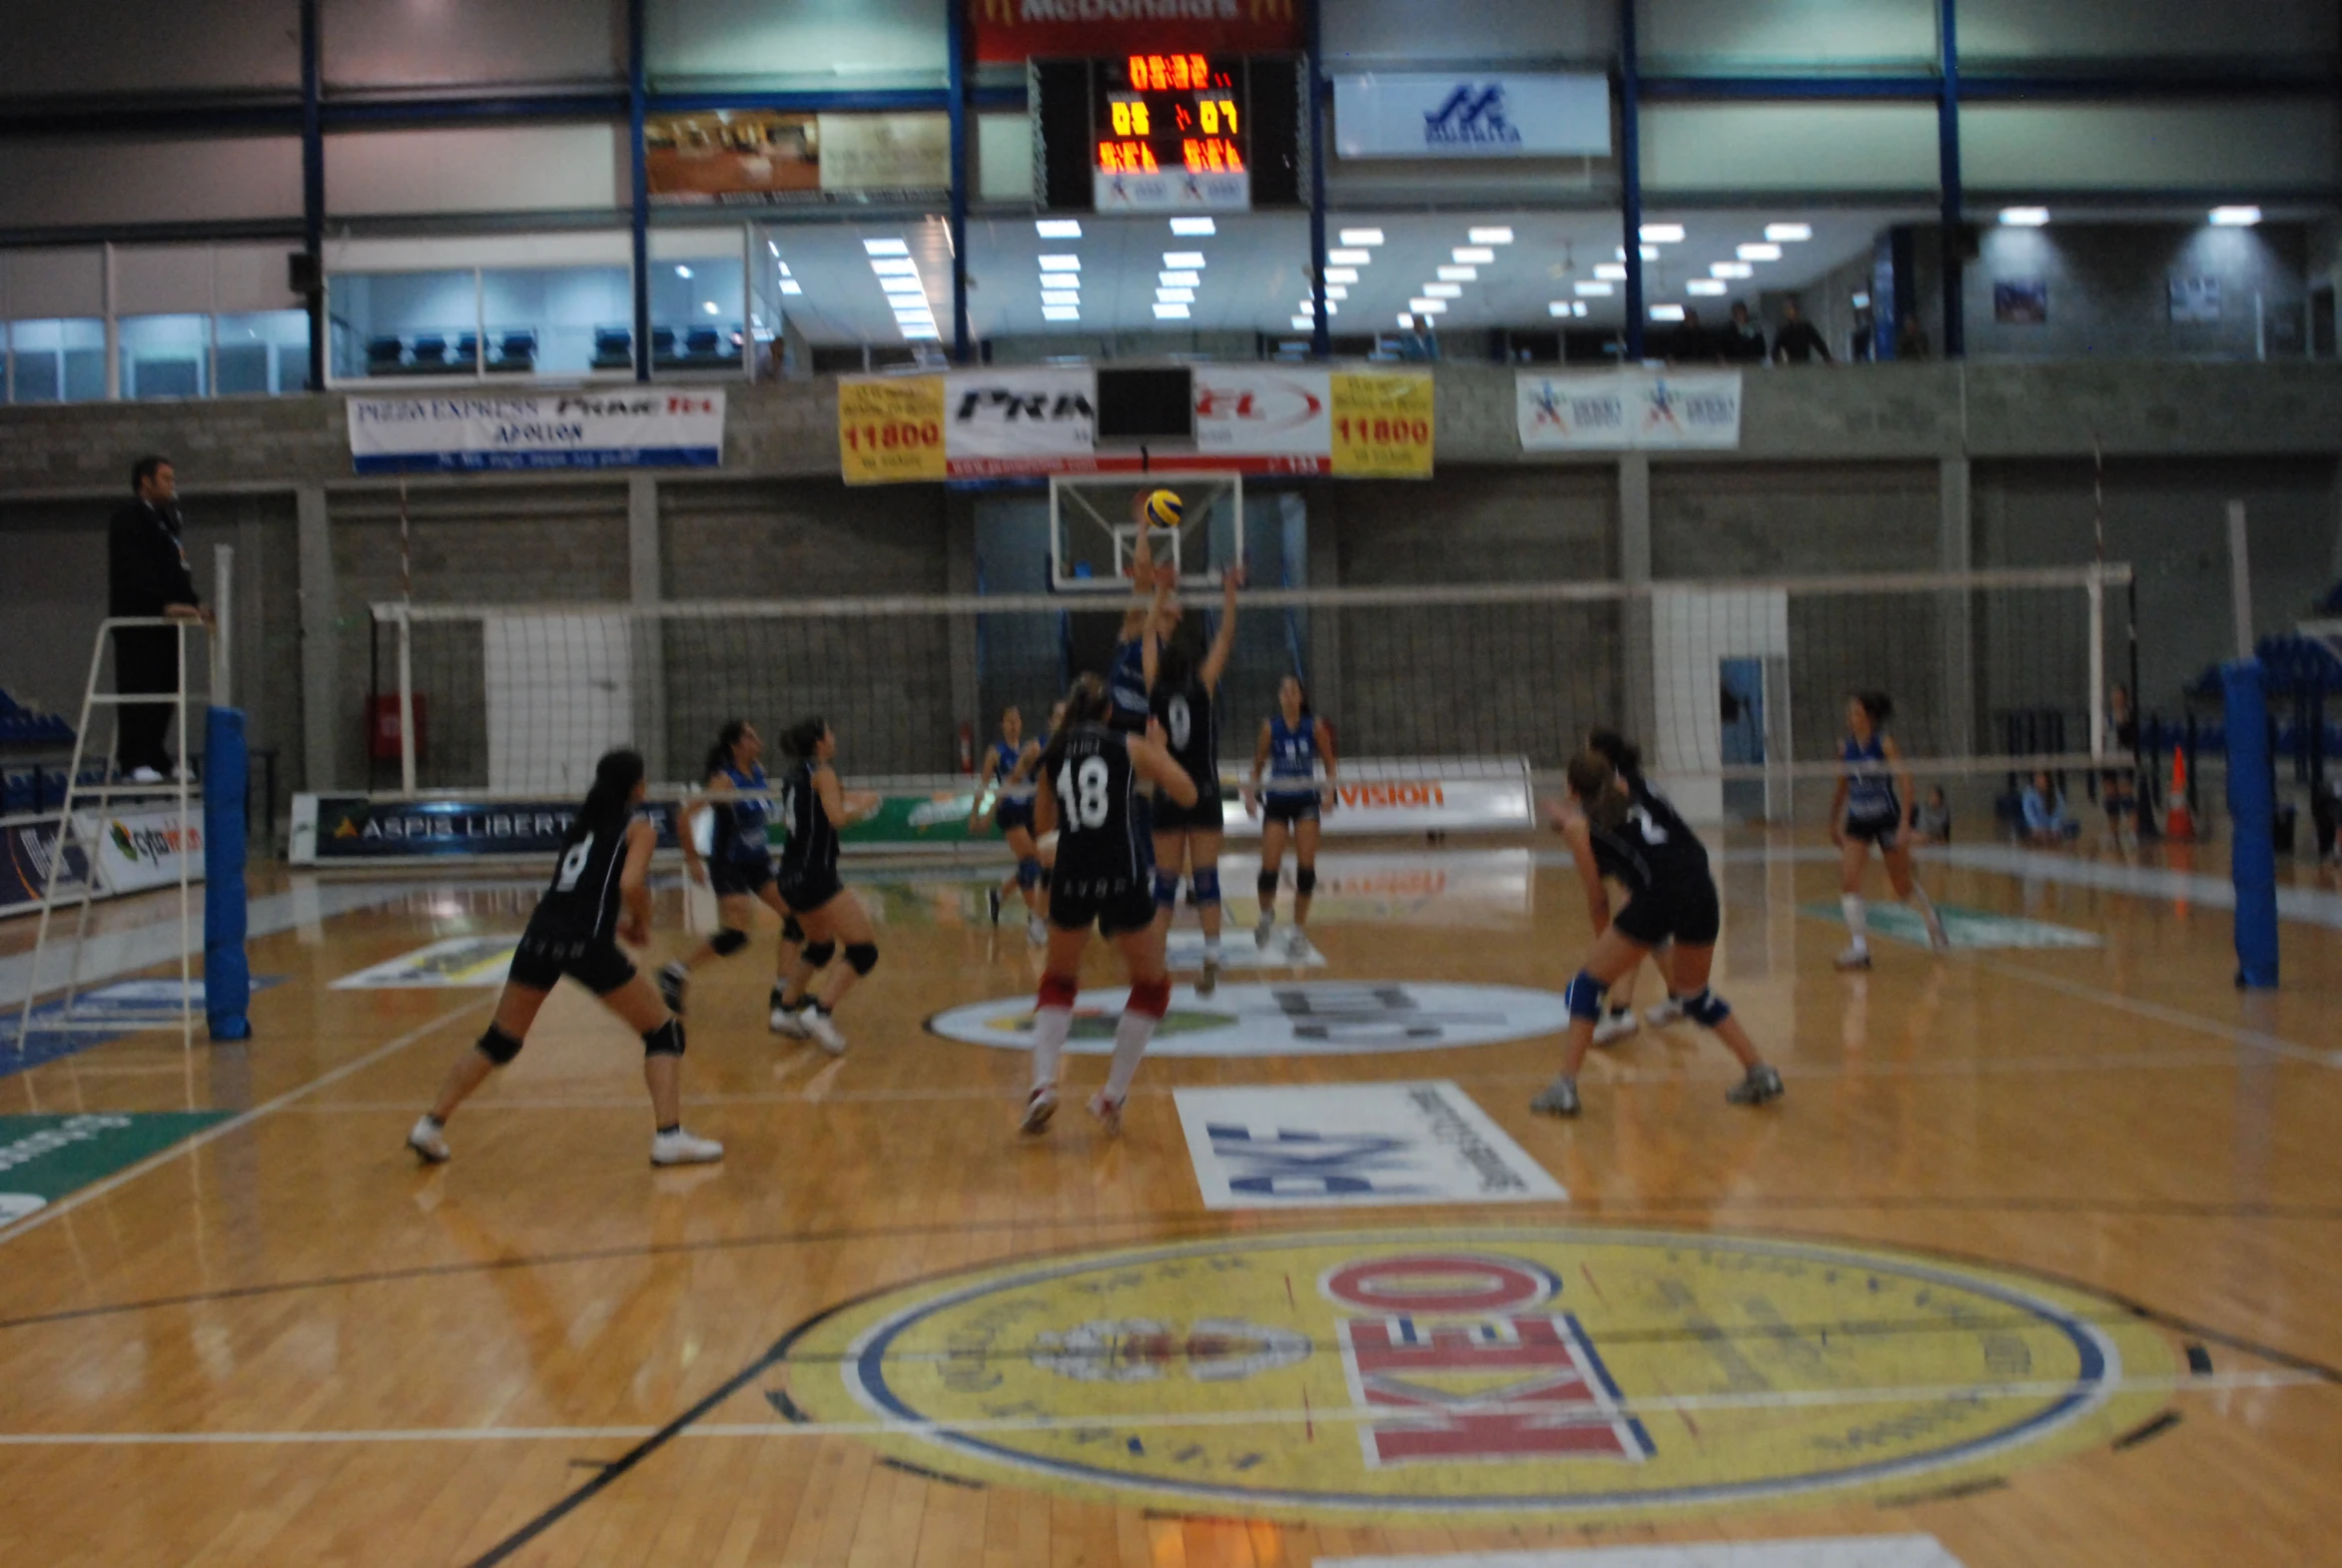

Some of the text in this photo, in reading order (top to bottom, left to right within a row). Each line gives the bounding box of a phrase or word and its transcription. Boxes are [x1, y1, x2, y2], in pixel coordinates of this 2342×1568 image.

[1021, 0, 1238, 21] McDonalds
[843, 418, 940, 452] 11800
[1333, 414, 1429, 446] 11800
[1056, 754, 1110, 834] 18
[362, 811, 576, 840] ASPIS LIBERT
[1316, 1255, 1658, 1471] KEO
